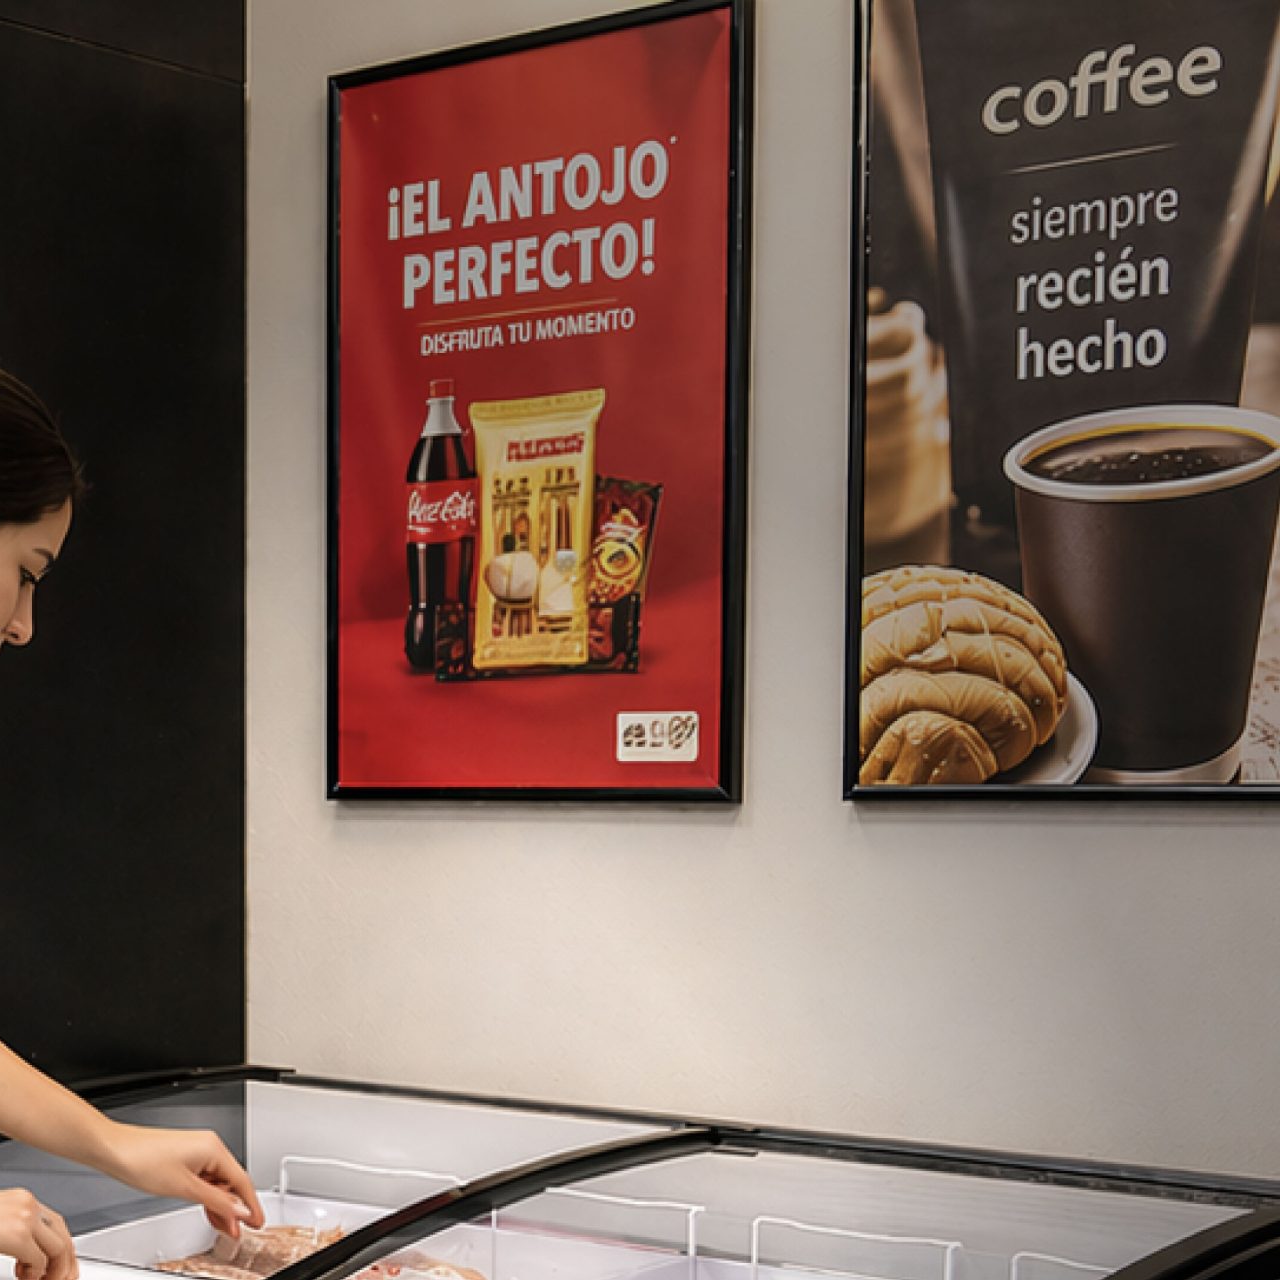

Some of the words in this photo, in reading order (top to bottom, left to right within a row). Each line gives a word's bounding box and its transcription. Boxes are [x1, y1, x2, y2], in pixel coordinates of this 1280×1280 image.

[982, 44, 1221, 134] coffee
[388, 179, 452, 240] ¡EL
[462, 139, 669, 228] ANTOJO
[1010, 187, 1179, 243] siempre
[403, 218, 655, 309] PERFECTO!
[1017, 246, 1169, 313] recién
[421, 325, 504, 356] DISFRUTA
[508, 321, 532, 344] TU
[535, 307, 636, 341] MOMENTO
[1017, 319, 1167, 380] hecho
